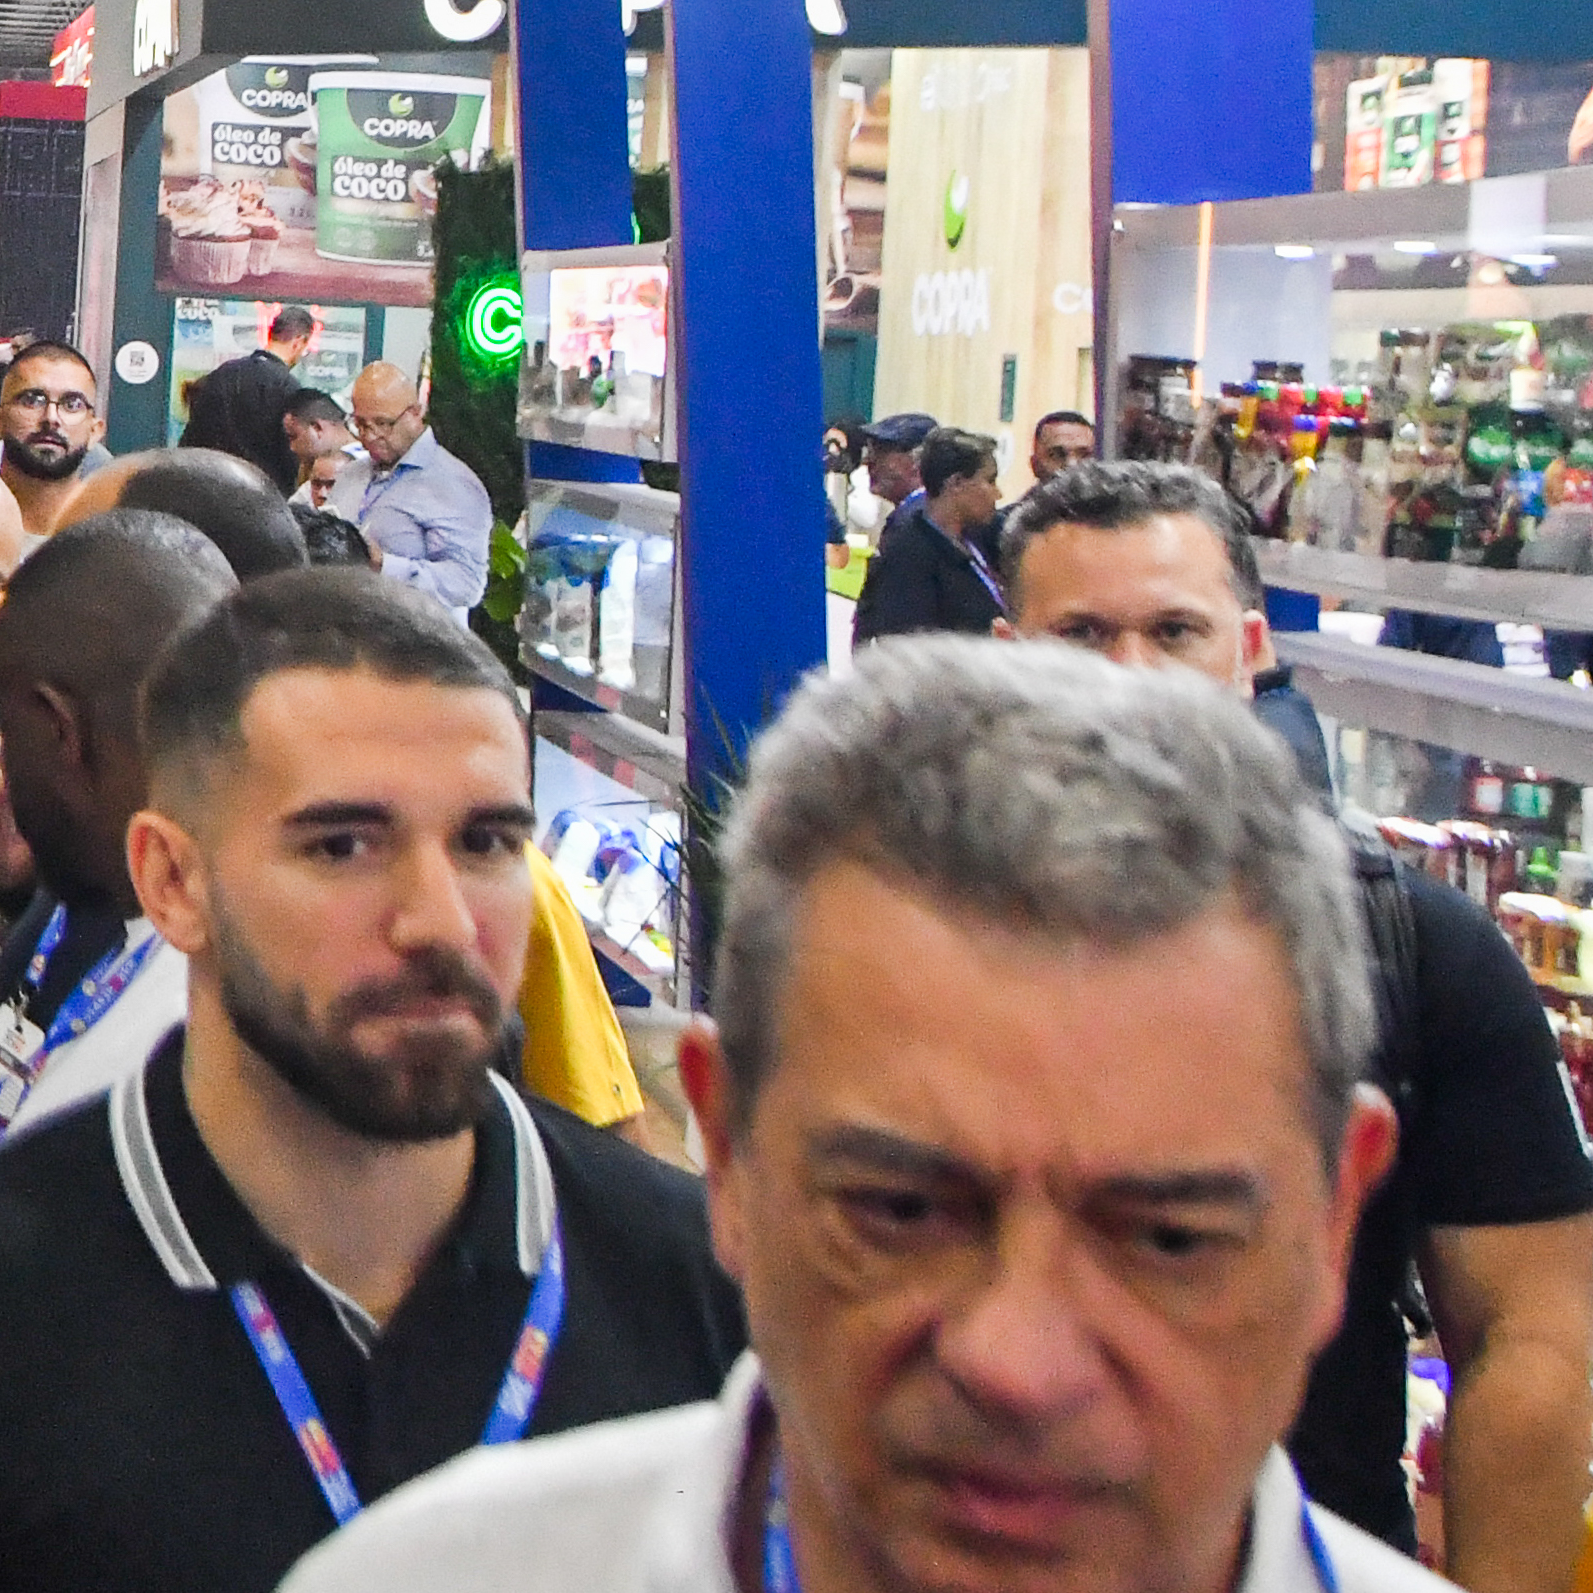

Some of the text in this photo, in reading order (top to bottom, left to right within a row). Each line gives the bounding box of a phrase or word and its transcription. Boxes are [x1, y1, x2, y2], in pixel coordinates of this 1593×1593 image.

[241, 89, 308, 109] COPRA
[261, 126, 282, 146] de
[363, 117, 437, 140] COPRA
[380, 158, 406, 179] de
